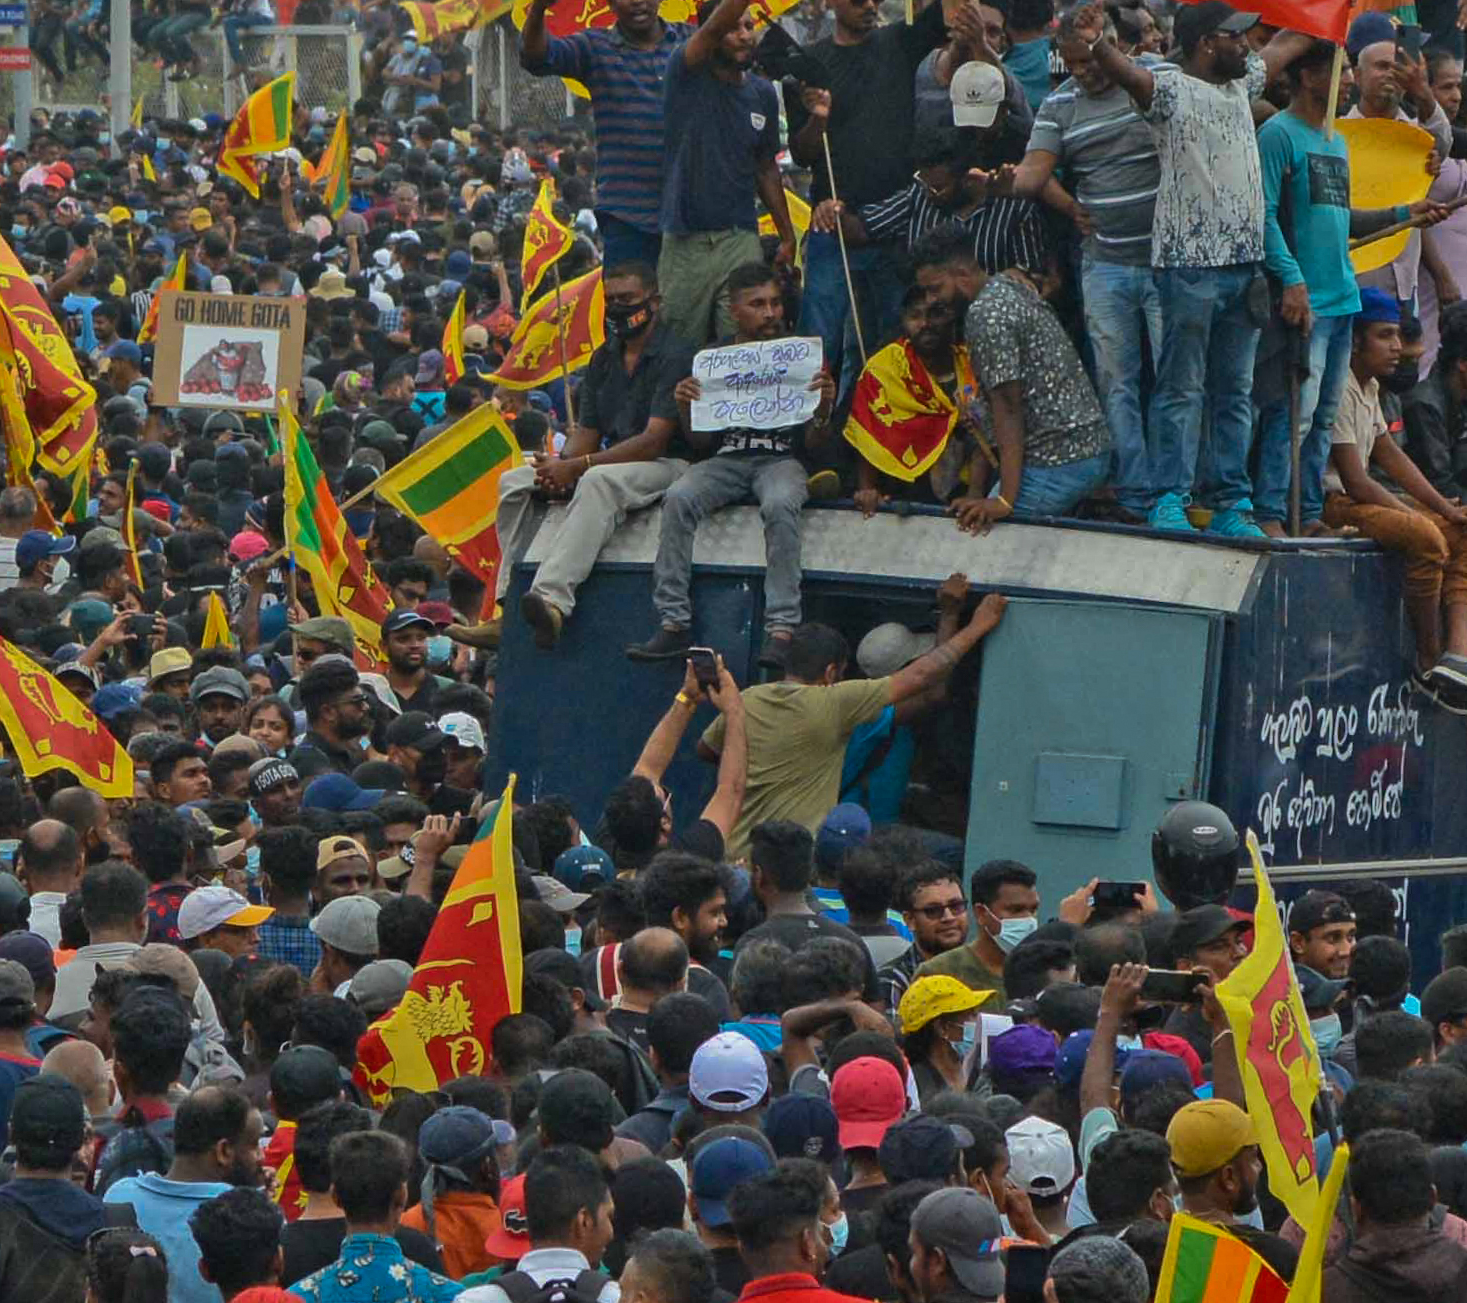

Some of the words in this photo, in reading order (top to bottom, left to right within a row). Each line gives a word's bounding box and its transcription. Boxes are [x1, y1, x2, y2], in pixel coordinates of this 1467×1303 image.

[174, 297, 195, 322] GO
[200, 298, 246, 326] HOME
[250, 304, 291, 328] GOTA
